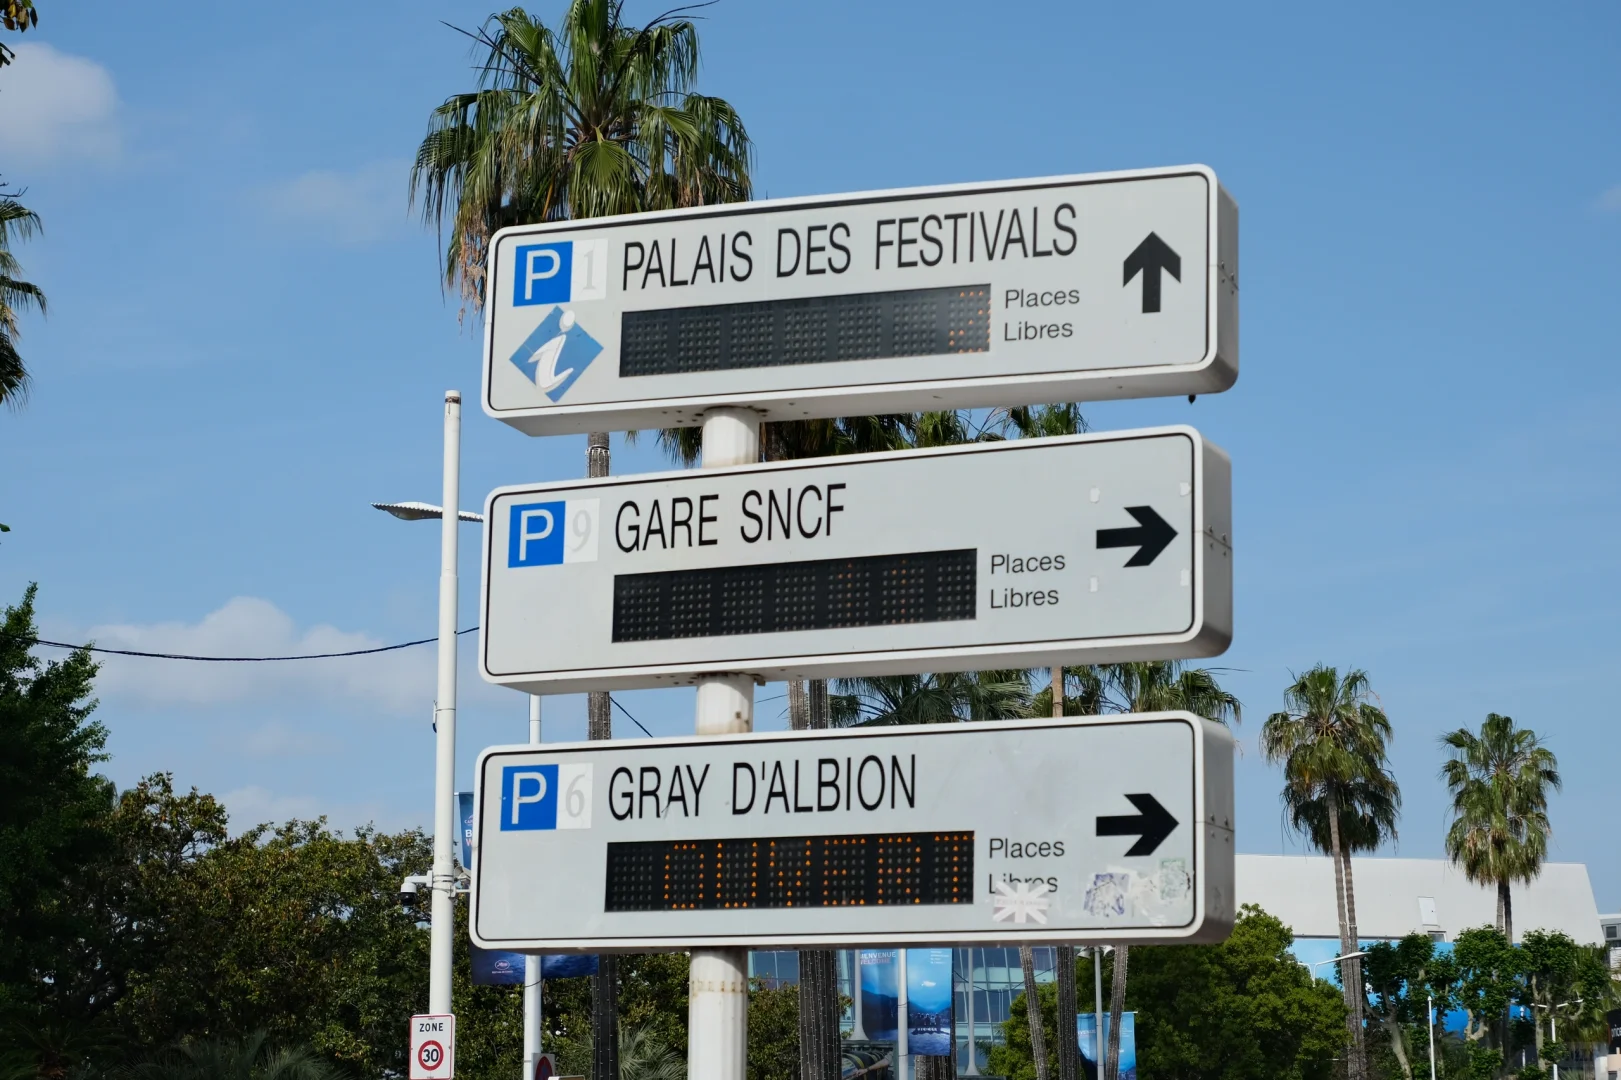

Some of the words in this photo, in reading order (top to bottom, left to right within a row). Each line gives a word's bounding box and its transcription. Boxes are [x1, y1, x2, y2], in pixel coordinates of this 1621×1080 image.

[622, 230, 753, 291] PALAIS
[776, 222, 851, 278] DES
[875, 203, 1078, 270] FESTIVALS
[525, 249, 561, 300] P
[1004, 288, 1080, 309] Places
[1004, 320, 1074, 342] Libres
[615, 493, 719, 553] GARE
[740, 483, 847, 544] SNCF
[519, 509, 554, 562] P
[571, 509, 592, 553] 9
[990, 554, 1066, 575] Places
[990, 588, 1059, 609] Libres
[511, 772, 547, 825] P
[565, 774, 586, 818] 6
[608, 763, 711, 822] GRAY
[732, 754, 916, 815] D'ALBION
[989, 837, 1065, 859] Places
[664, 836, 975, 909] OUVERT
[861, 951, 897, 960] IENVENUE
[419, 1022, 444, 1033] ZONE
[422, 1048, 439, 1063] 30
